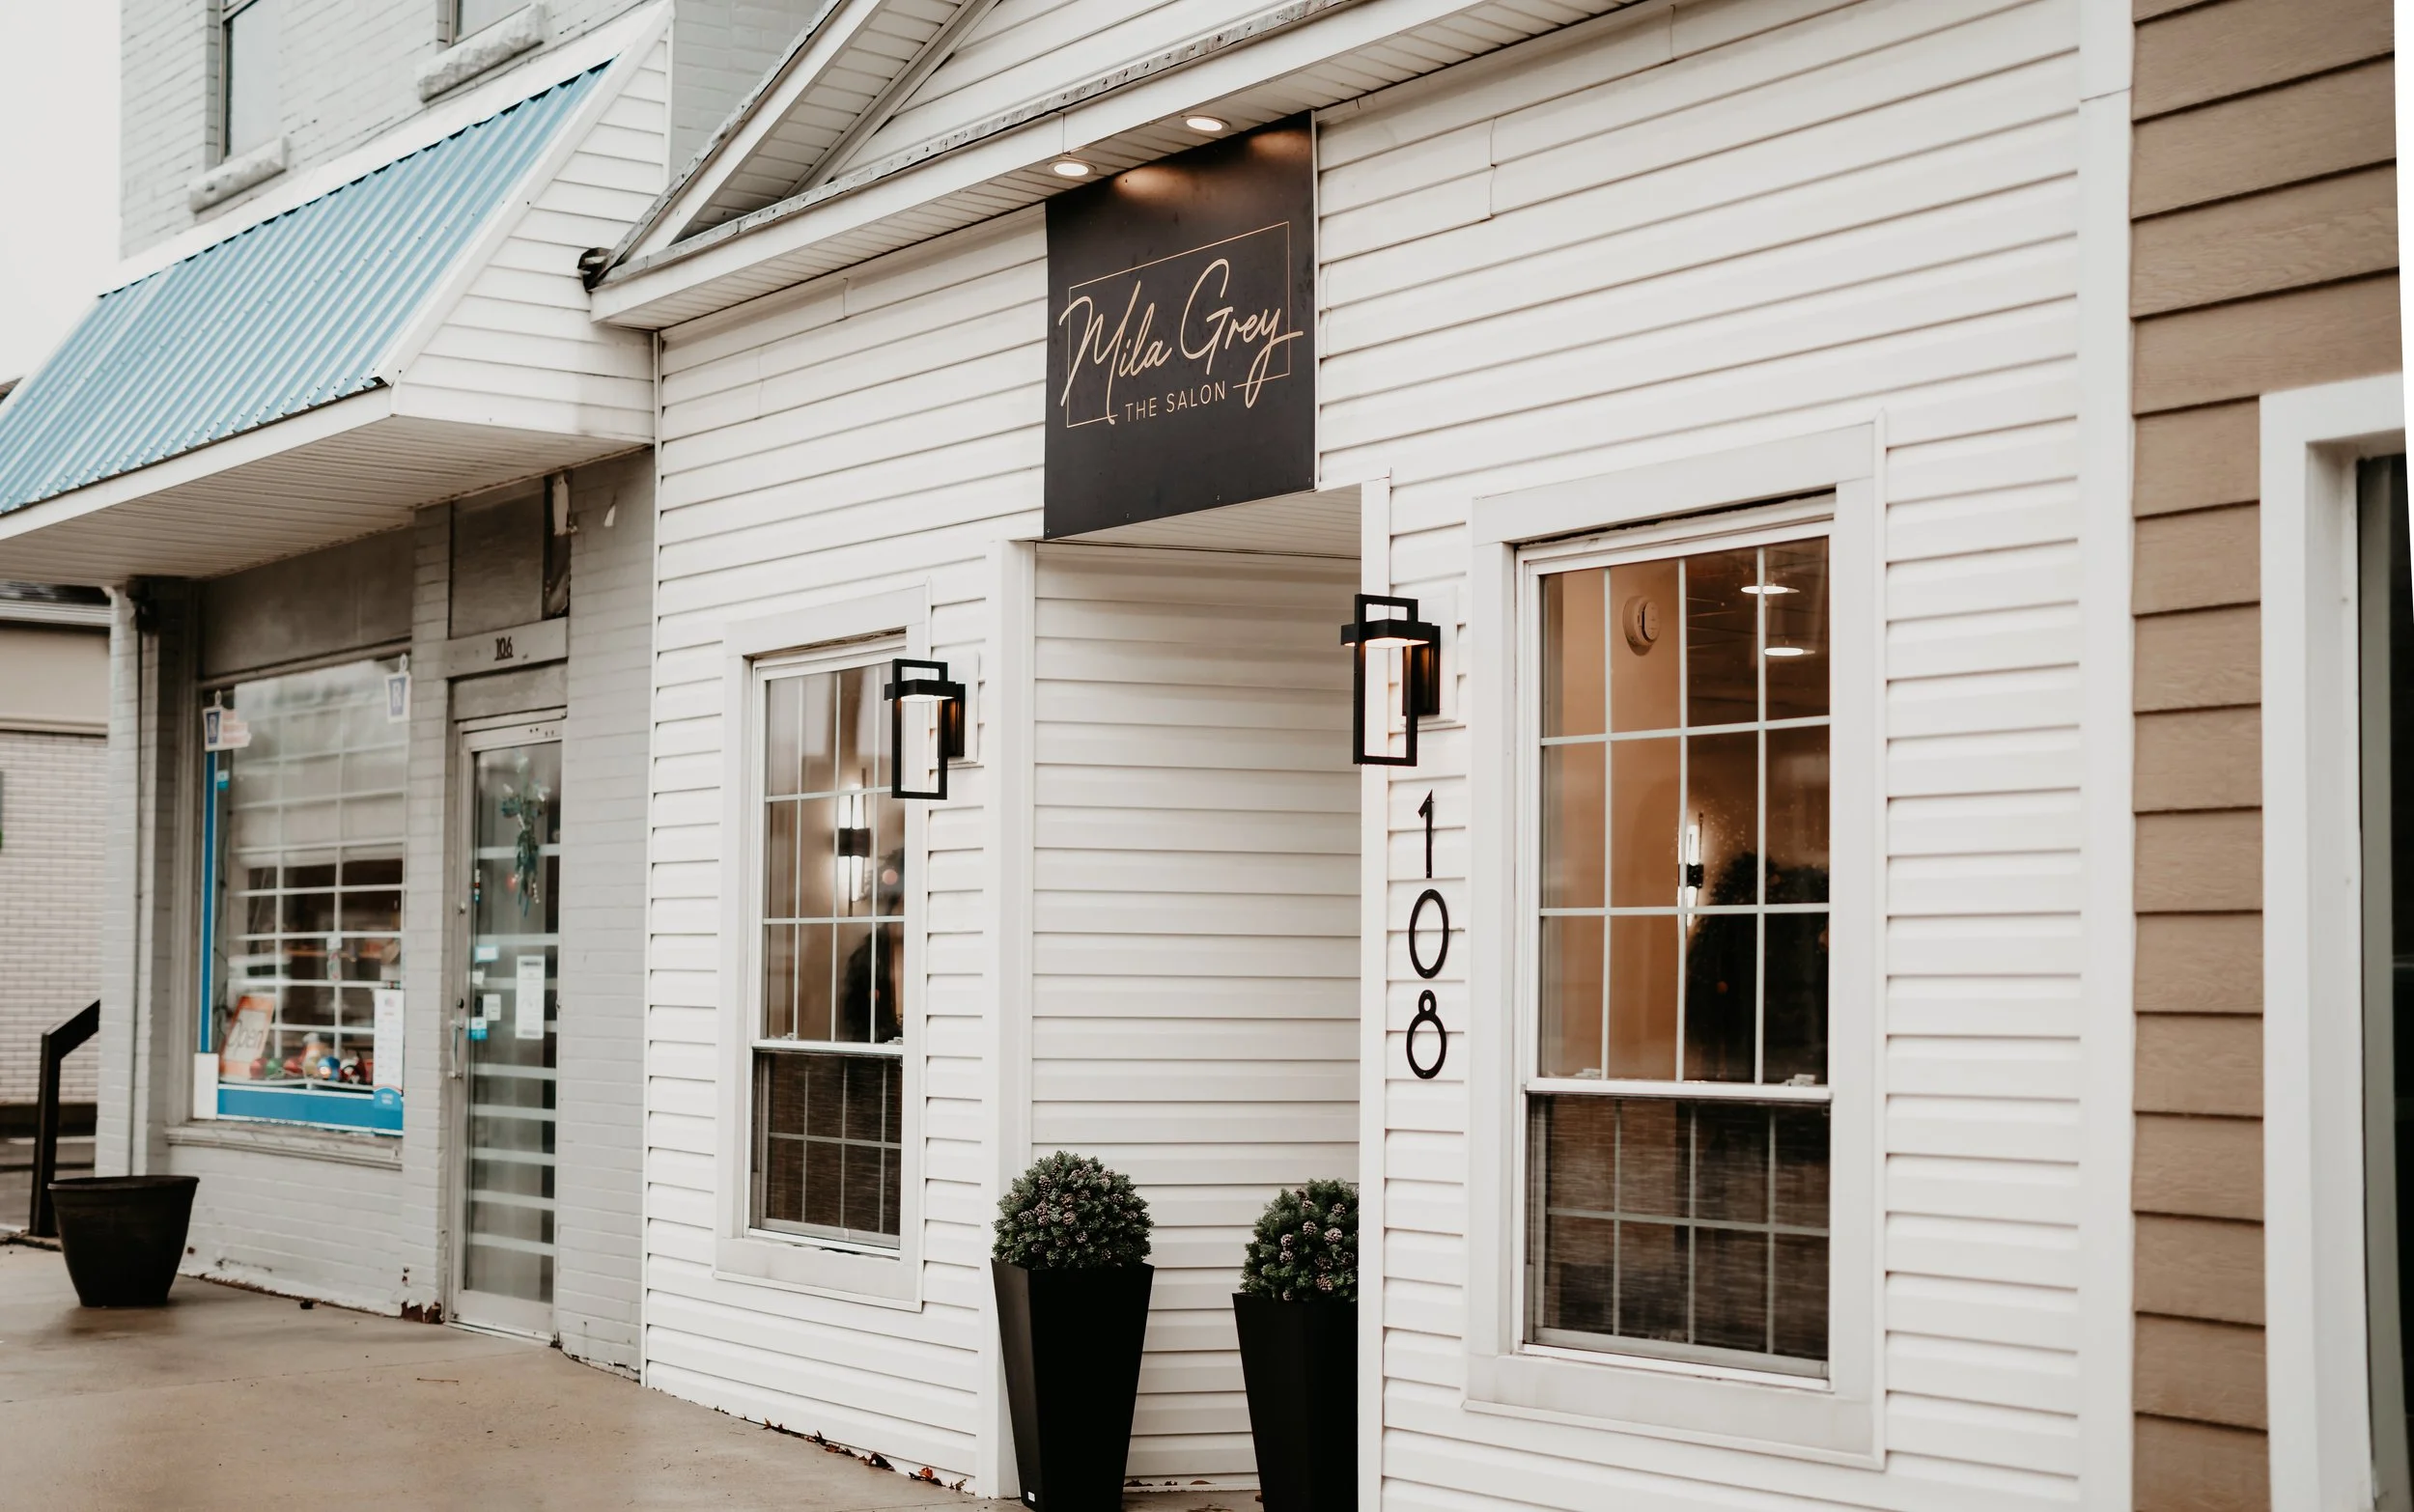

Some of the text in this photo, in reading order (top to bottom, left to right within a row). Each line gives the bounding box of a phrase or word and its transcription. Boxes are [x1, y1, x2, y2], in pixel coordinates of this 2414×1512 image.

[1058, 258, 1304, 425] Mila Grey
[1125, 380, 1225, 422] THE SALON
[494, 635, 514, 661] 106
[1406, 789, 1449, 1079] 108
